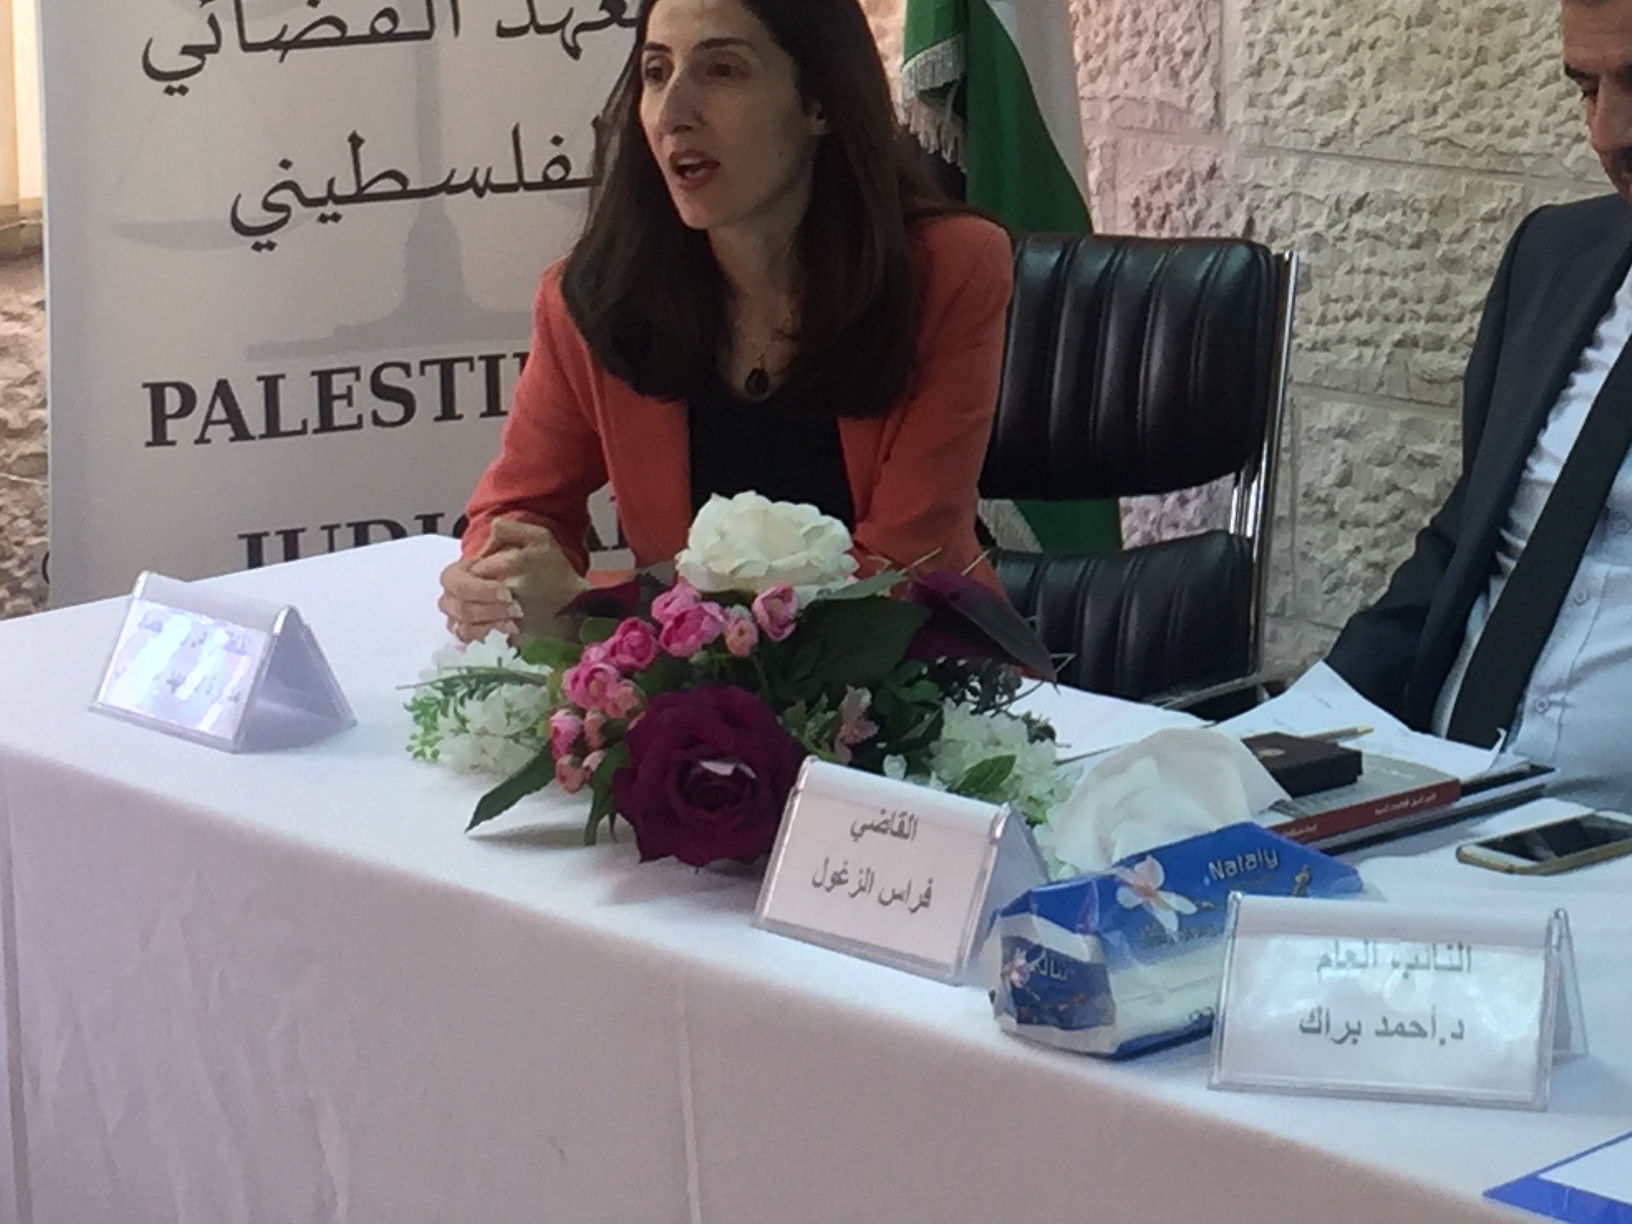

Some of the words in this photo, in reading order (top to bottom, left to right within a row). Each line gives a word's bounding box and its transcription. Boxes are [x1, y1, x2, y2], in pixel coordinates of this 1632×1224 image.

[230, 113, 602, 252] لفلسطيني
[141, 350, 530, 448] PALESTI
[850, 808, 919, 842] القاضي
[811, 856, 875, 898] الزغول
[1207, 847, 1279, 881] Nataly
[877, 877, 934, 914] فراس
[1316, 938, 1378, 983] العام
[1299, 1005, 1363, 1046] براك
